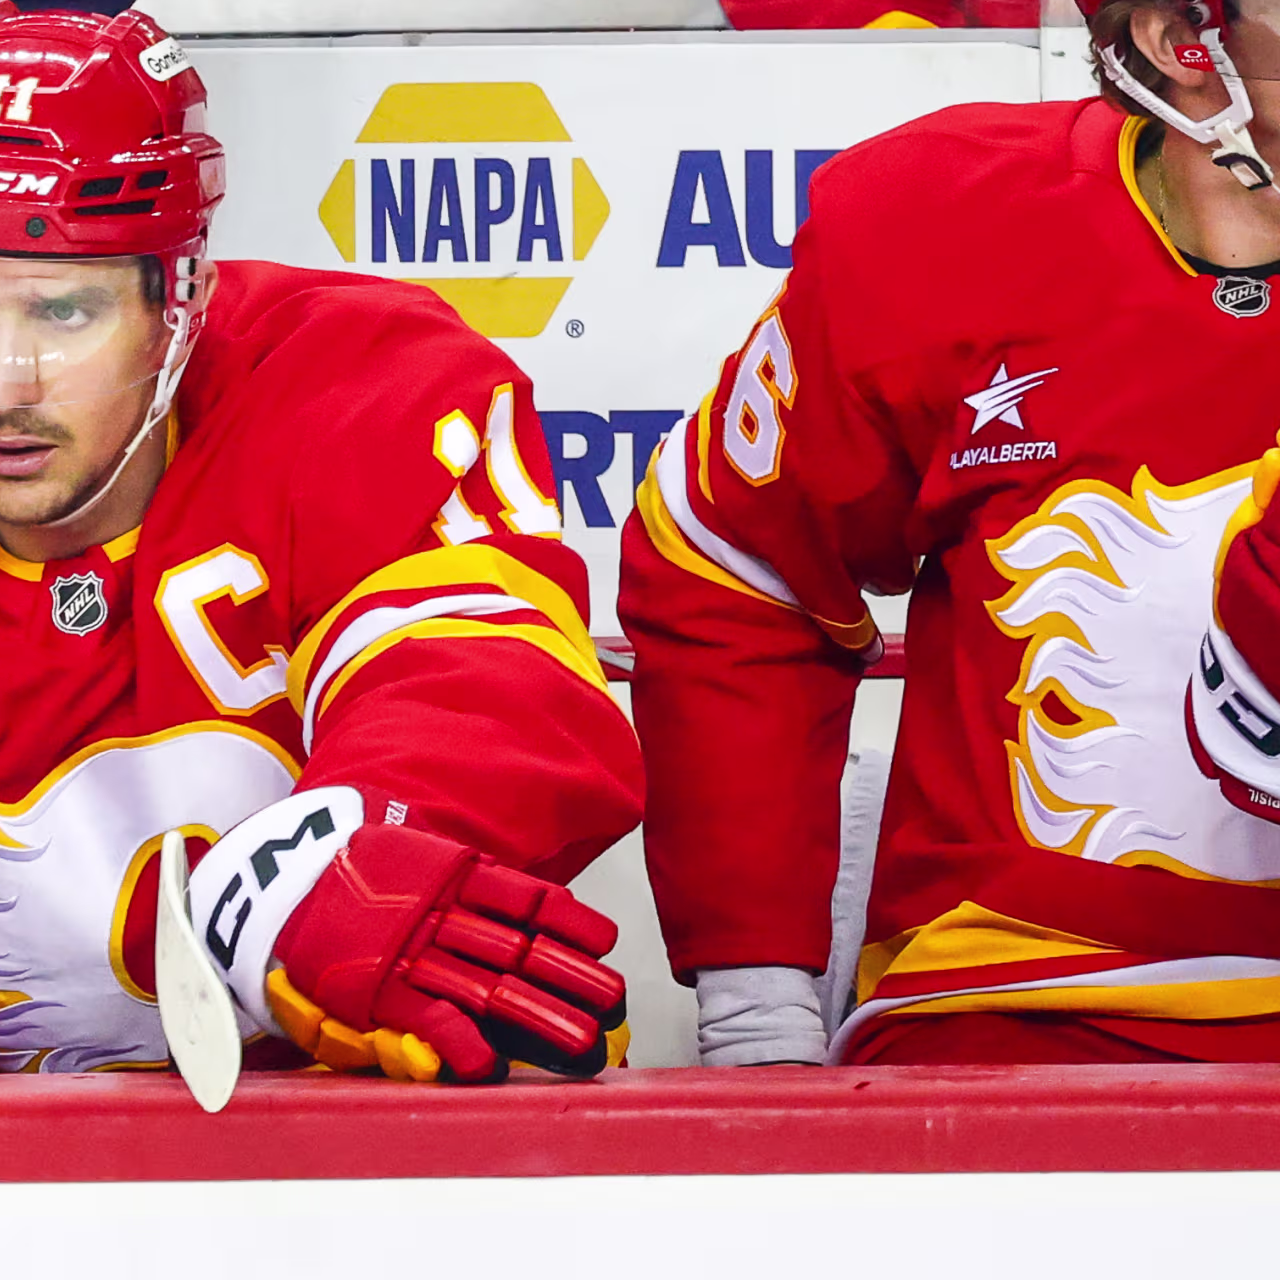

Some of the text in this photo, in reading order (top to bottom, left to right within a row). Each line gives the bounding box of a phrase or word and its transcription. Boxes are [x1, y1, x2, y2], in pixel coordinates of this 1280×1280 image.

[371, 157, 564, 263] NAPA
[1225, 286, 1259, 304] NHL
[723, 307, 798, 488] 6
[950, 441, 1057, 470] LAYALBERTA
[64, 587, 95, 623] NHL
[153, 542, 290, 717] C
[206, 806, 336, 973] CM
